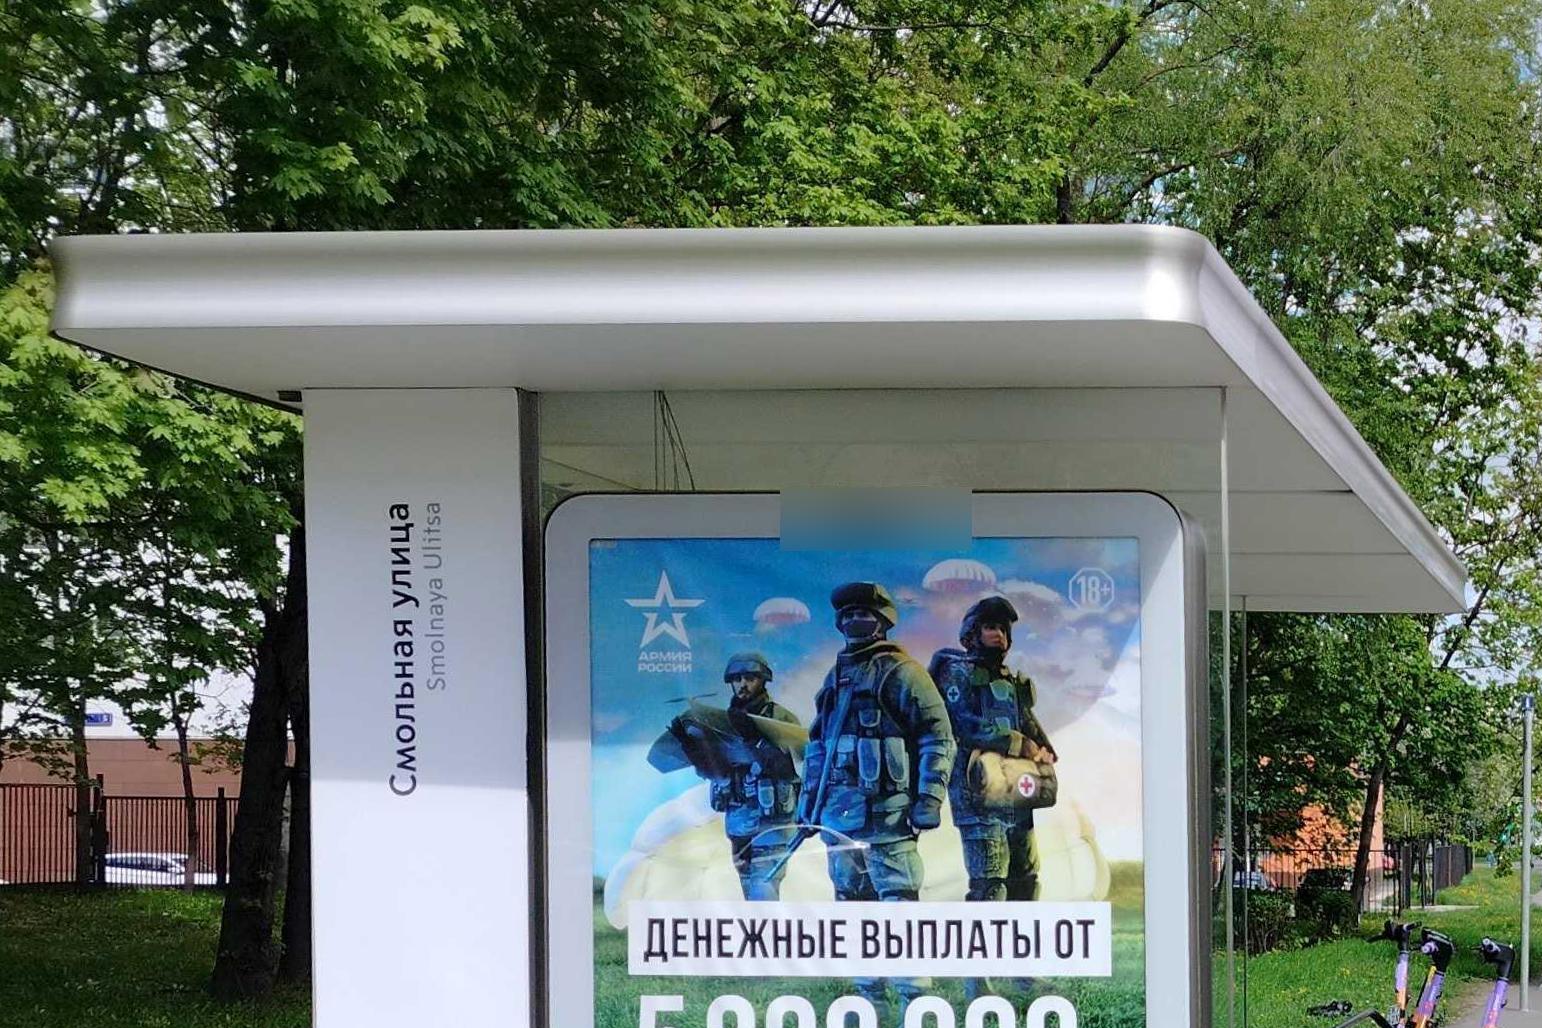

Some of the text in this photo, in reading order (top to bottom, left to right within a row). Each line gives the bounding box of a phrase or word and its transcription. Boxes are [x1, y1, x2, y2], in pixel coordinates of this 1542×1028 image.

[421, 501, 448, 692] Smolnaya Ulitsa
[1076, 575, 1111, 604] 18+
[388, 502, 419, 797] Смольная улица
[637, 663, 692, 673] РОССИИ
[638, 650, 692, 661] АРМИЯ
[643, 918, 1097, 963] ДЕНЕЖНЫЕ ВЫПЛАТЫ ОТ
